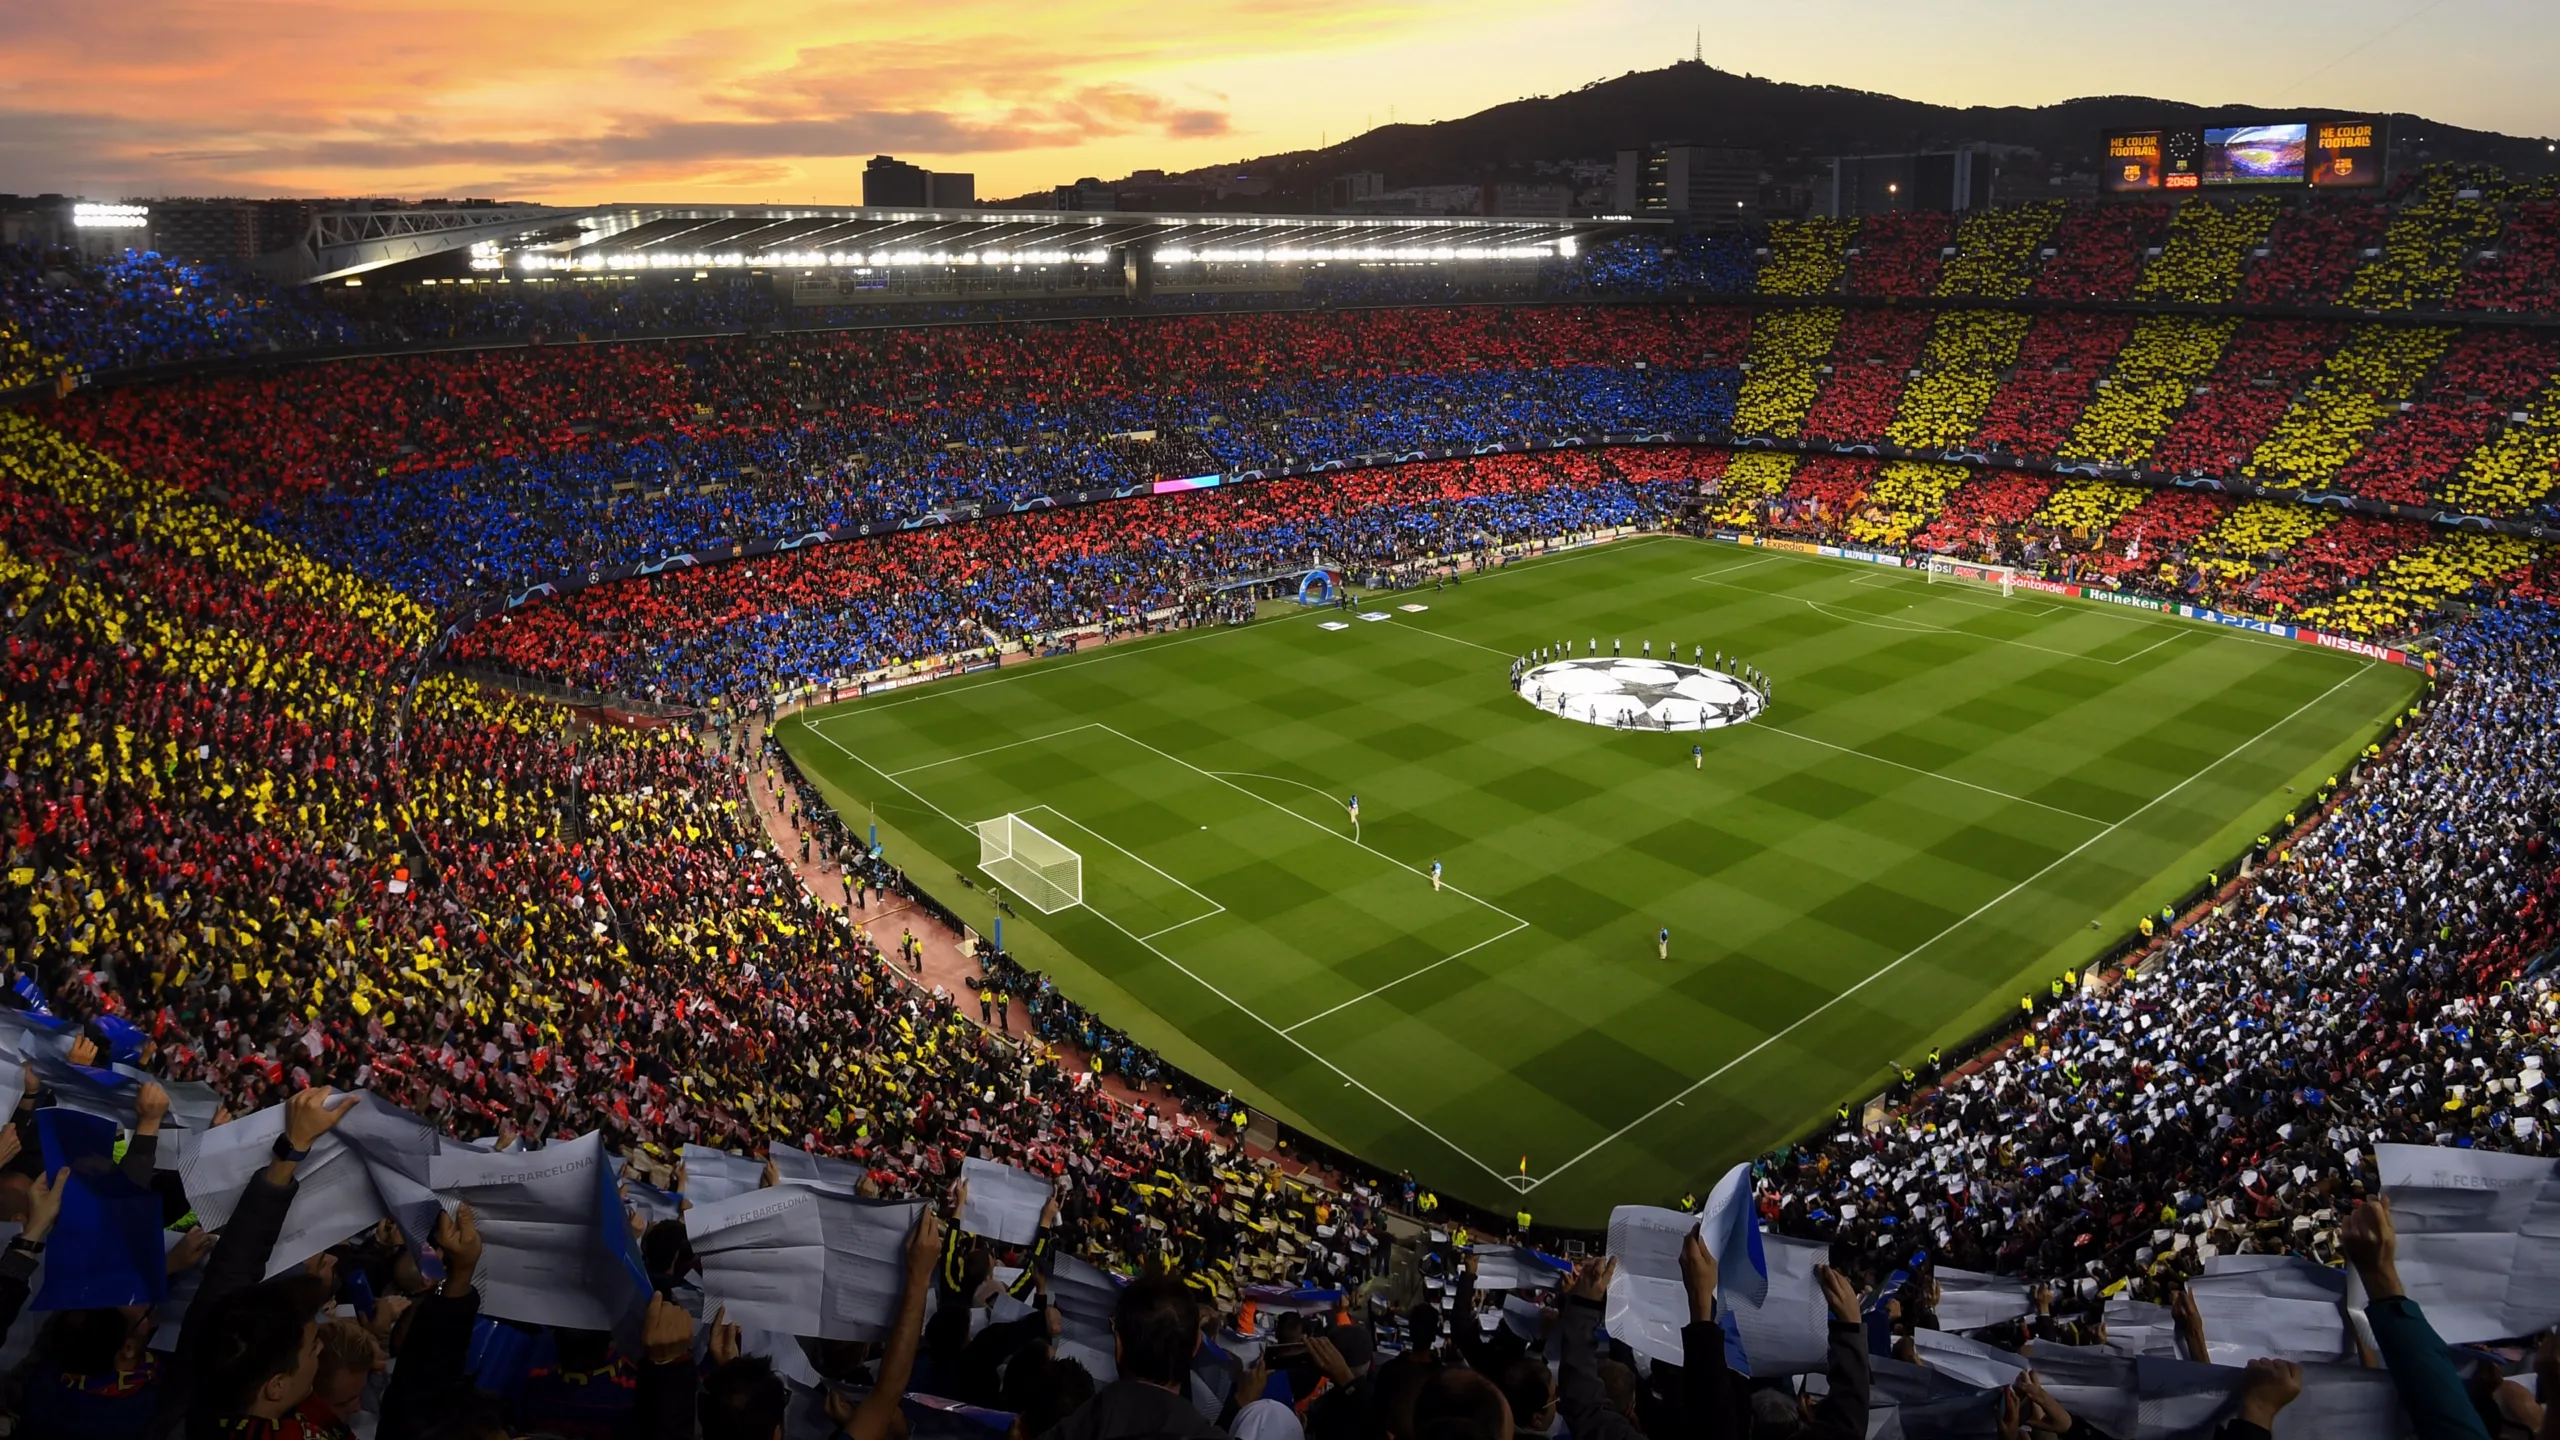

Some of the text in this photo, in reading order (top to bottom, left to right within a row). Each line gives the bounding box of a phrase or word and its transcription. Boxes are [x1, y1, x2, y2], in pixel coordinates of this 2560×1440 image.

[2337, 126, 2372, 137] COLOR
[2126, 136, 2158, 146] COLOR
[2318, 137, 2371, 149] FOOTBALL
[2110, 146, 2157, 157] FOOTBALL
[2166, 176, 2198, 187] 20:56
[1766, 539, 1804, 552] Expedia
[1919, 561, 1952, 574] pepsi
[2009, 574, 2067, 594] Santander
[2089, 588, 2159, 610] Heineken
[2222, 614, 2266, 632] PS4
[2317, 633, 2388, 660] NISSAN
[898, 674, 930, 687] NISSAN
[500, 1156, 594, 1184] FC BARCELONA
[2453, 1174, 2469, 1187] FC
[740, 1194, 808, 1223] FC BARCELONA
